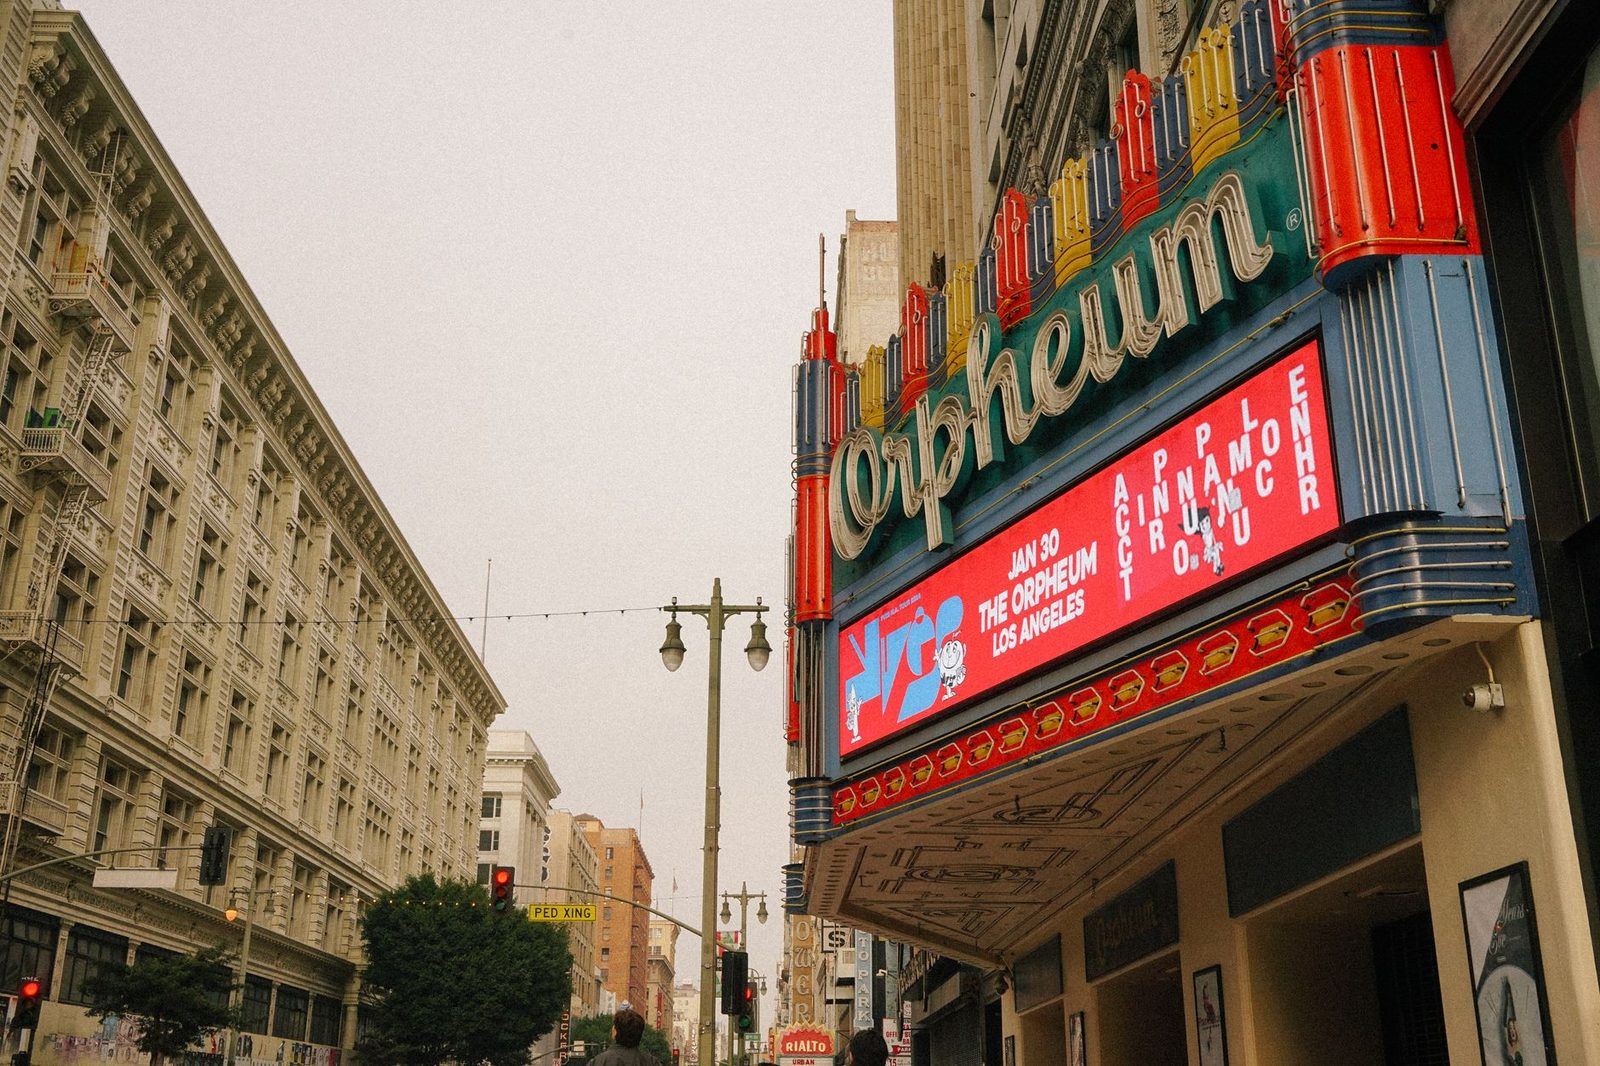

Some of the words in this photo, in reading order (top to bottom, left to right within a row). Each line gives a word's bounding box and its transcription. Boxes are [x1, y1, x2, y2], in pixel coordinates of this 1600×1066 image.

[830, 171, 1276, 561] Orpheum
[1008, 539, 1036, 580] JAN
[1040, 528, 1060, 562] 30
[979, 590, 1008, 634] THE
[1011, 540, 1098, 615] ORPHEUM
[993, 623, 1017, 658] LOS
[1019, 588, 1085, 645] ANGELES
[534, 907, 558, 918] PED
[563, 907, 591, 918] XING
[858, 969, 870, 1021] PARK
[785, 1040, 826, 1053] RIALTO
